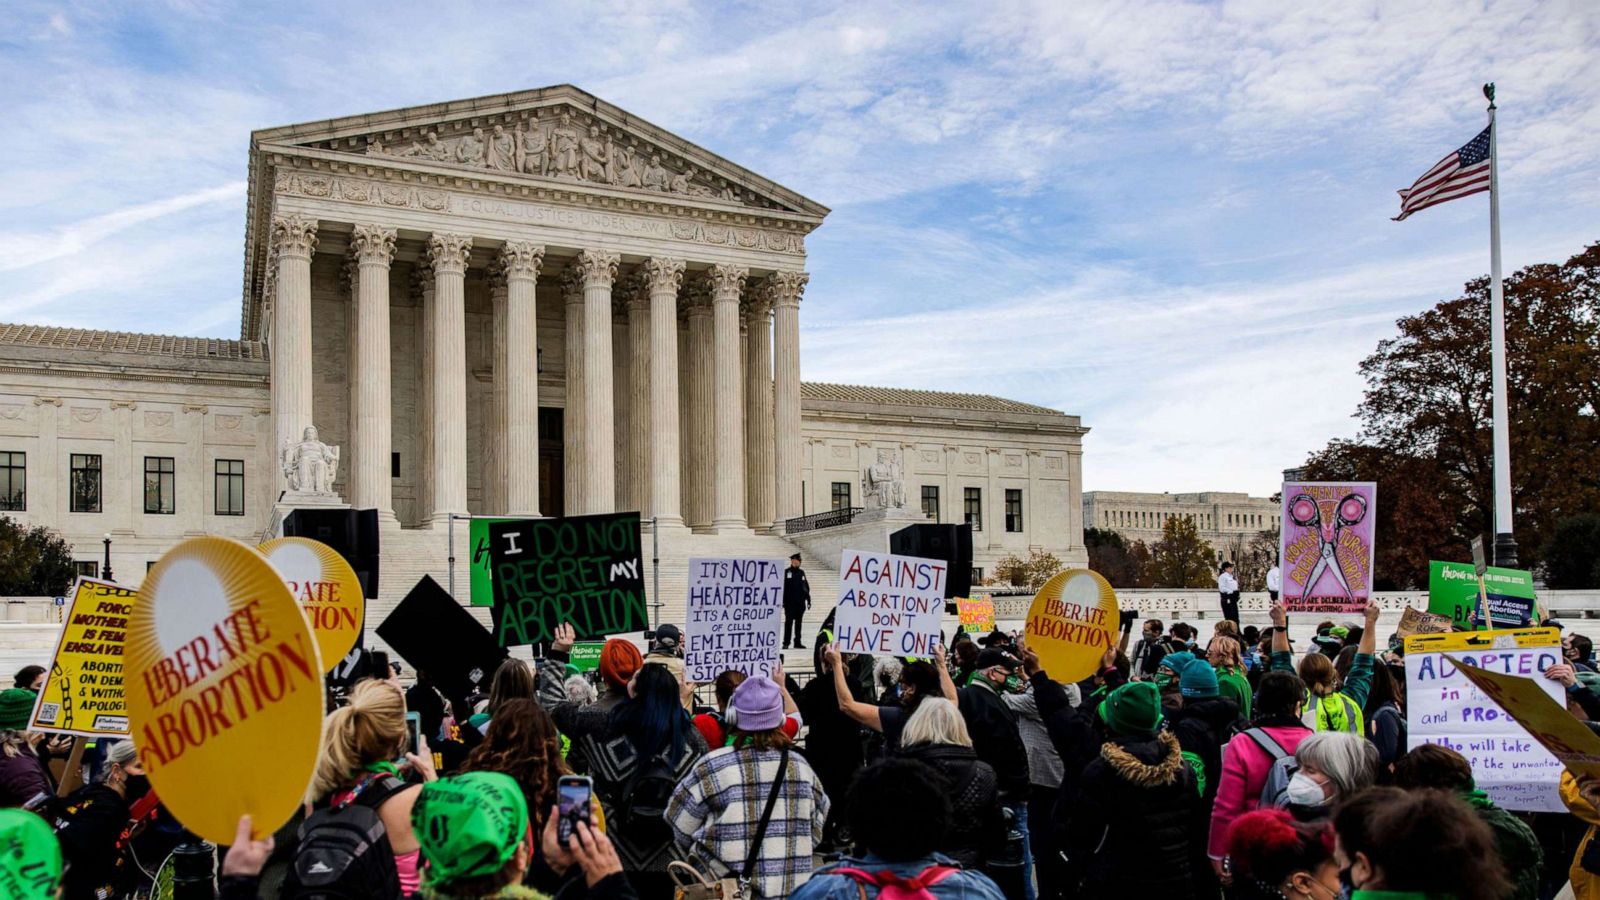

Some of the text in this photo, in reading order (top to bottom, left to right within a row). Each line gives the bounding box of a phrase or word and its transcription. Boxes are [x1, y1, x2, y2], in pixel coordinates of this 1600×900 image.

[462, 199, 660, 233] EQUAL JUSTICE UNDER LAW
[1302, 486, 1334, 499] WHEN
[502, 532, 523, 555] I
[533, 521, 579, 560] DO
[586, 517, 640, 553] NOT
[498, 555, 639, 600] REGRET MY
[700, 559, 779, 583] IT'S NOT A
[844, 555, 946, 591] AGAINST
[690, 586, 782, 607] HEARTBEAT
[1481, 599, 1529, 610] qual Access
[96, 602, 131, 615] FORC
[721, 609, 729, 621] A
[733, 608, 774, 621] GROUP
[1044, 598, 1108, 627] LIBERATE
[72, 614, 128, 629] MOTHER
[498, 587, 649, 648] ABORTION
[871, 612, 916, 629] DON'T
[82, 629, 127, 643] IS FEM
[712, 623, 752, 632] OF CELLS
[1026, 615, 1114, 650] ABORTION
[691, 631, 776, 652] EMITTING
[838, 625, 940, 655] HAVE ONE
[64, 642, 124, 656] ENSLAVE
[142, 599, 271, 708] LIBERATE
[686, 648, 777, 667] ELECTRICAL
[79, 674, 124, 686] ON DEM
[79, 687, 86, 697] &
[1441, 687, 1460, 700] in
[140, 632, 314, 773] ABORTION
[1421, 711, 1448, 725] and
[1426, 736, 1463, 752] ho
[1470, 739, 1495, 751] will
[1502, 739, 1531, 752] take
[1484, 757, 1504, 769] the
